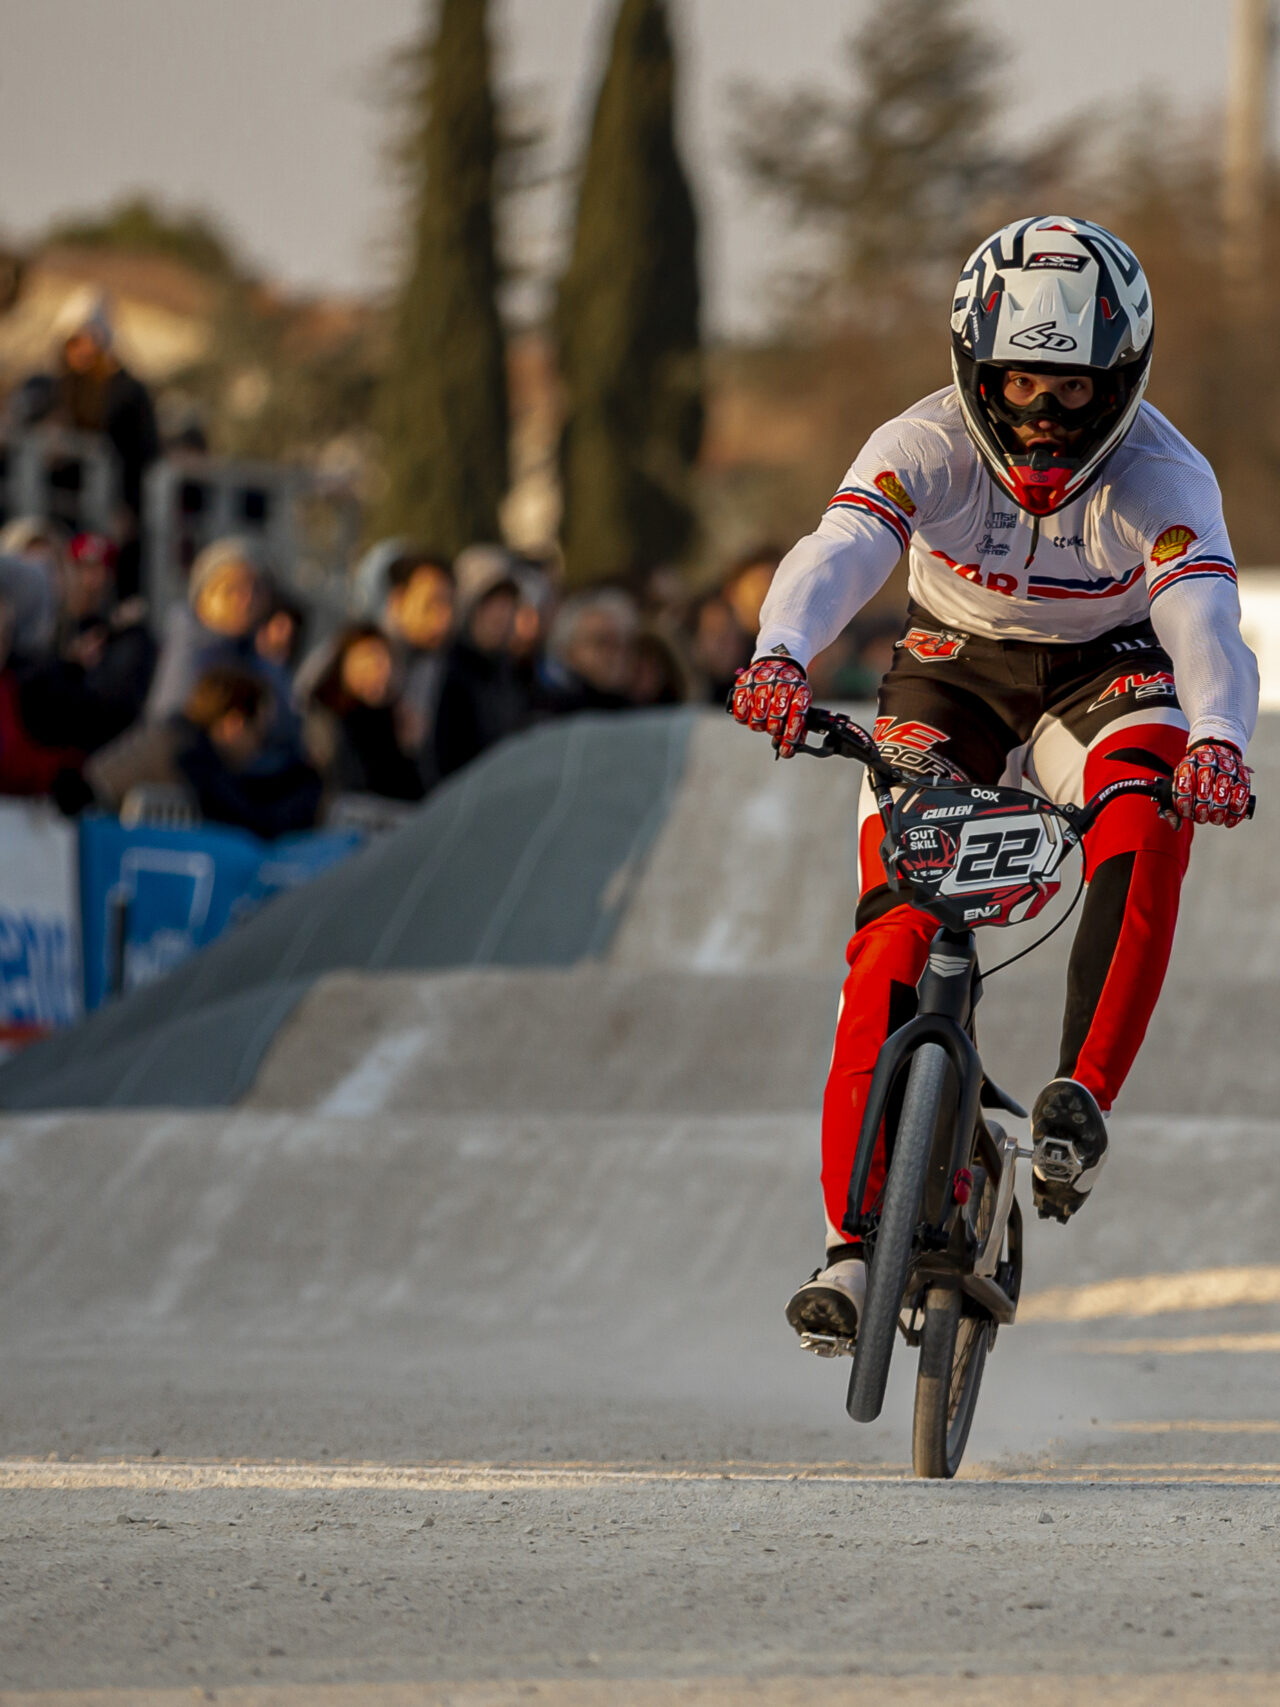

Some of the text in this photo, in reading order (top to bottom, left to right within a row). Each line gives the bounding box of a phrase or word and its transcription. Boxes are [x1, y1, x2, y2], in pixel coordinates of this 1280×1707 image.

[1009, 321, 1077, 352] 6D
[1098, 779, 1148, 800] RENTHAL
[921, 804, 974, 820] CULLEN
[909, 829, 935, 841] OUT
[910, 839, 938, 851] SKILL
[955, 827, 1041, 883] 22
